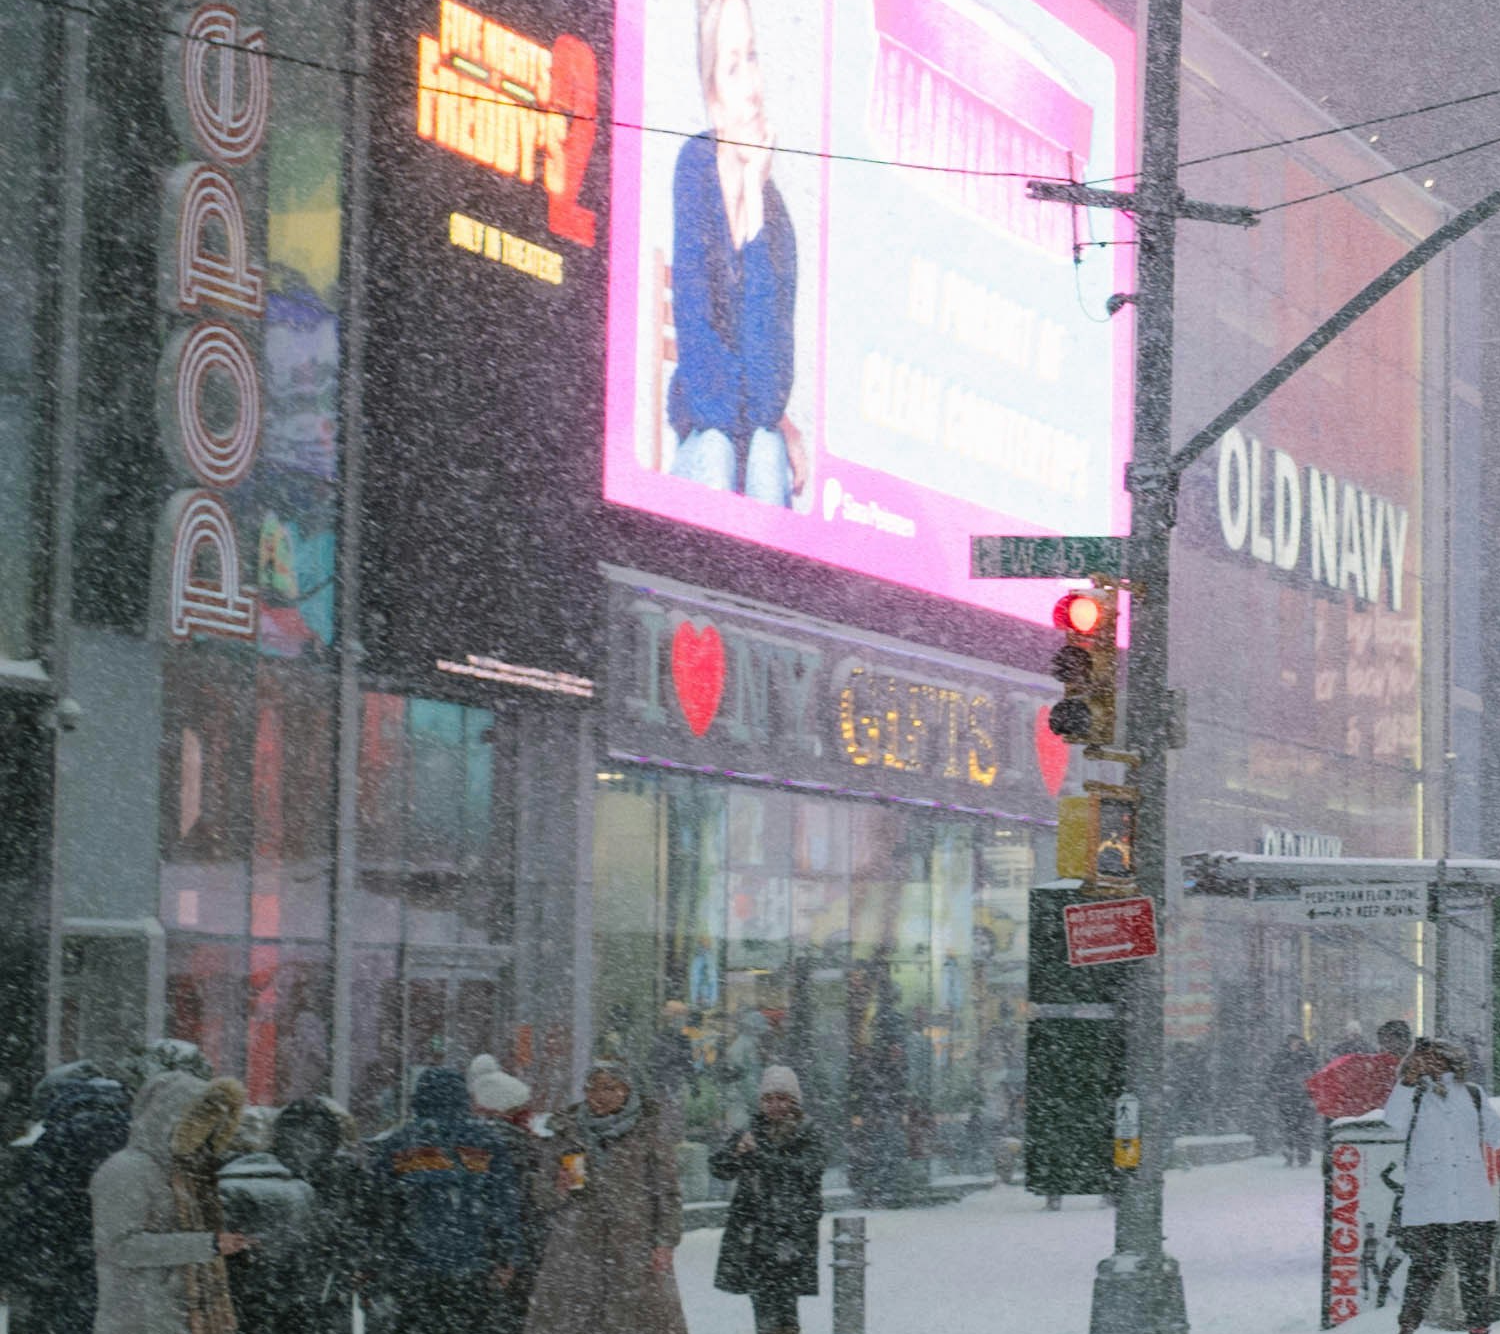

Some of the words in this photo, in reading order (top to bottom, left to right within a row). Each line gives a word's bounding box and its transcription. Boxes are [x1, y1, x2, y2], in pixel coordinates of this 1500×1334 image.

[417, 32, 567, 195] FREDDY'S
[1217, 426, 1301, 571] OLD
[1310, 465, 1408, 614] NAVY
[840, 666, 998, 787] GIFTS
[1330, 1143, 1361, 1324] CHICAGO
